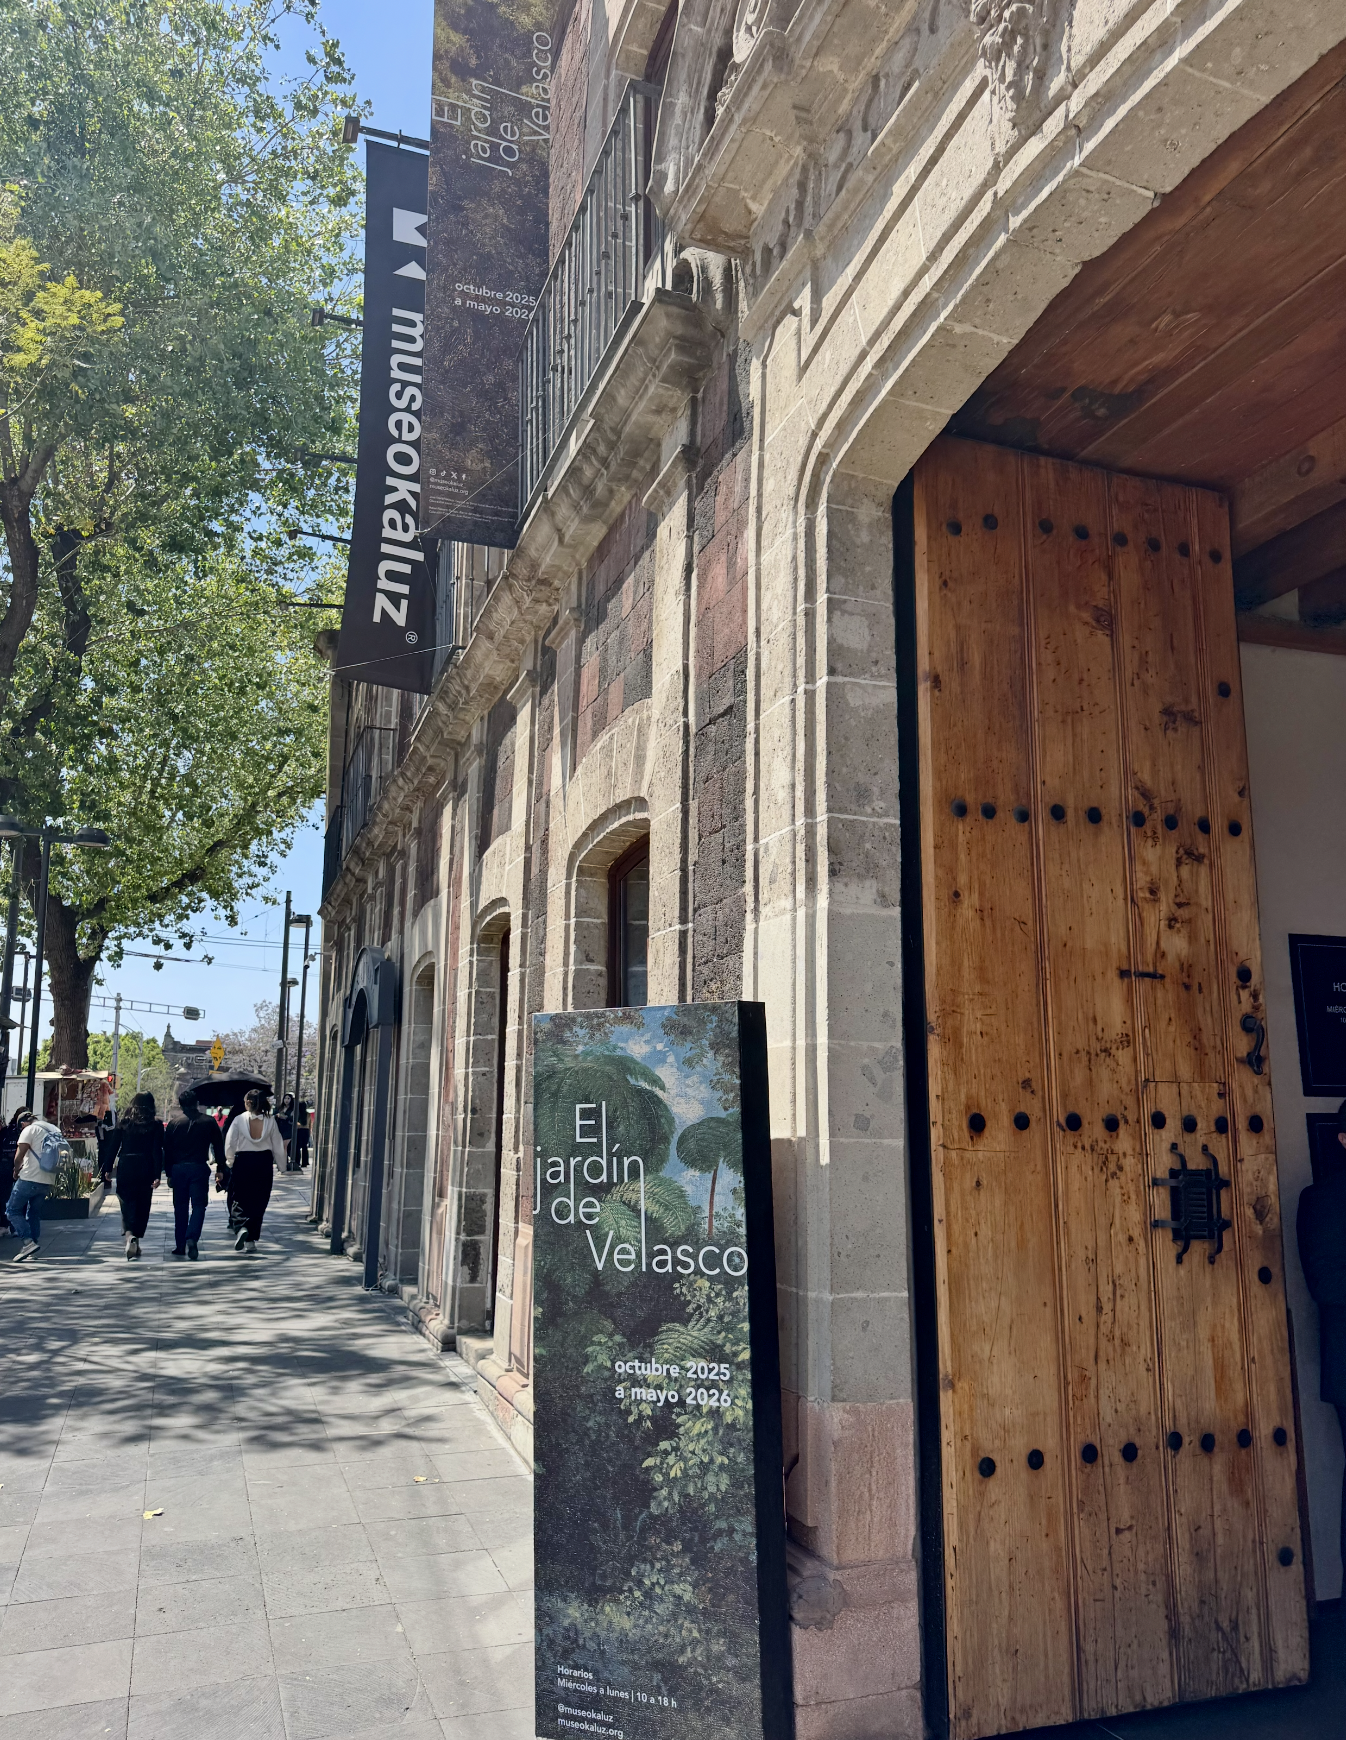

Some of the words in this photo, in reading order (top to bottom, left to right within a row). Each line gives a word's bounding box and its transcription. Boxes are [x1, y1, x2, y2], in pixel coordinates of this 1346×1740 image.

[523, 31, 551, 140] Velasco
[432, 95, 462, 126] El
[499, 122, 520, 161] de
[455, 283, 503, 299] octubre
[505, 291, 536, 306] 2025
[455, 297, 462, 305] a
[466, 300, 500, 314] mayo
[575, 1101, 606, 1143] El
[533, 1144, 643, 1214] jardín
[551, 1197, 600, 1225] de
[585, 1229, 748, 1276] Velasco
[615, 1358, 680, 1377] octubre
[686, 1361, 730, 1380] 2025
[615, 1386, 624, 1398] a
[631, 1388, 679, 1406] mayo
[686, 1387, 731, 1407] 2026
[557, 1665, 593, 1680] Horarios
[557, 1678, 597, 1693] Miércoles
[606, 1686, 630, 1699] lunes
[636, 1692, 648, 1702] 10
[649, 1696, 655, 1704] a
[657, 1696, 669, 1707] 18
[671, 1698, 677, 1708] h
[557, 1703, 614, 1722] @museokaluz
[557, 1718, 624, 1740] museokaluz.org
